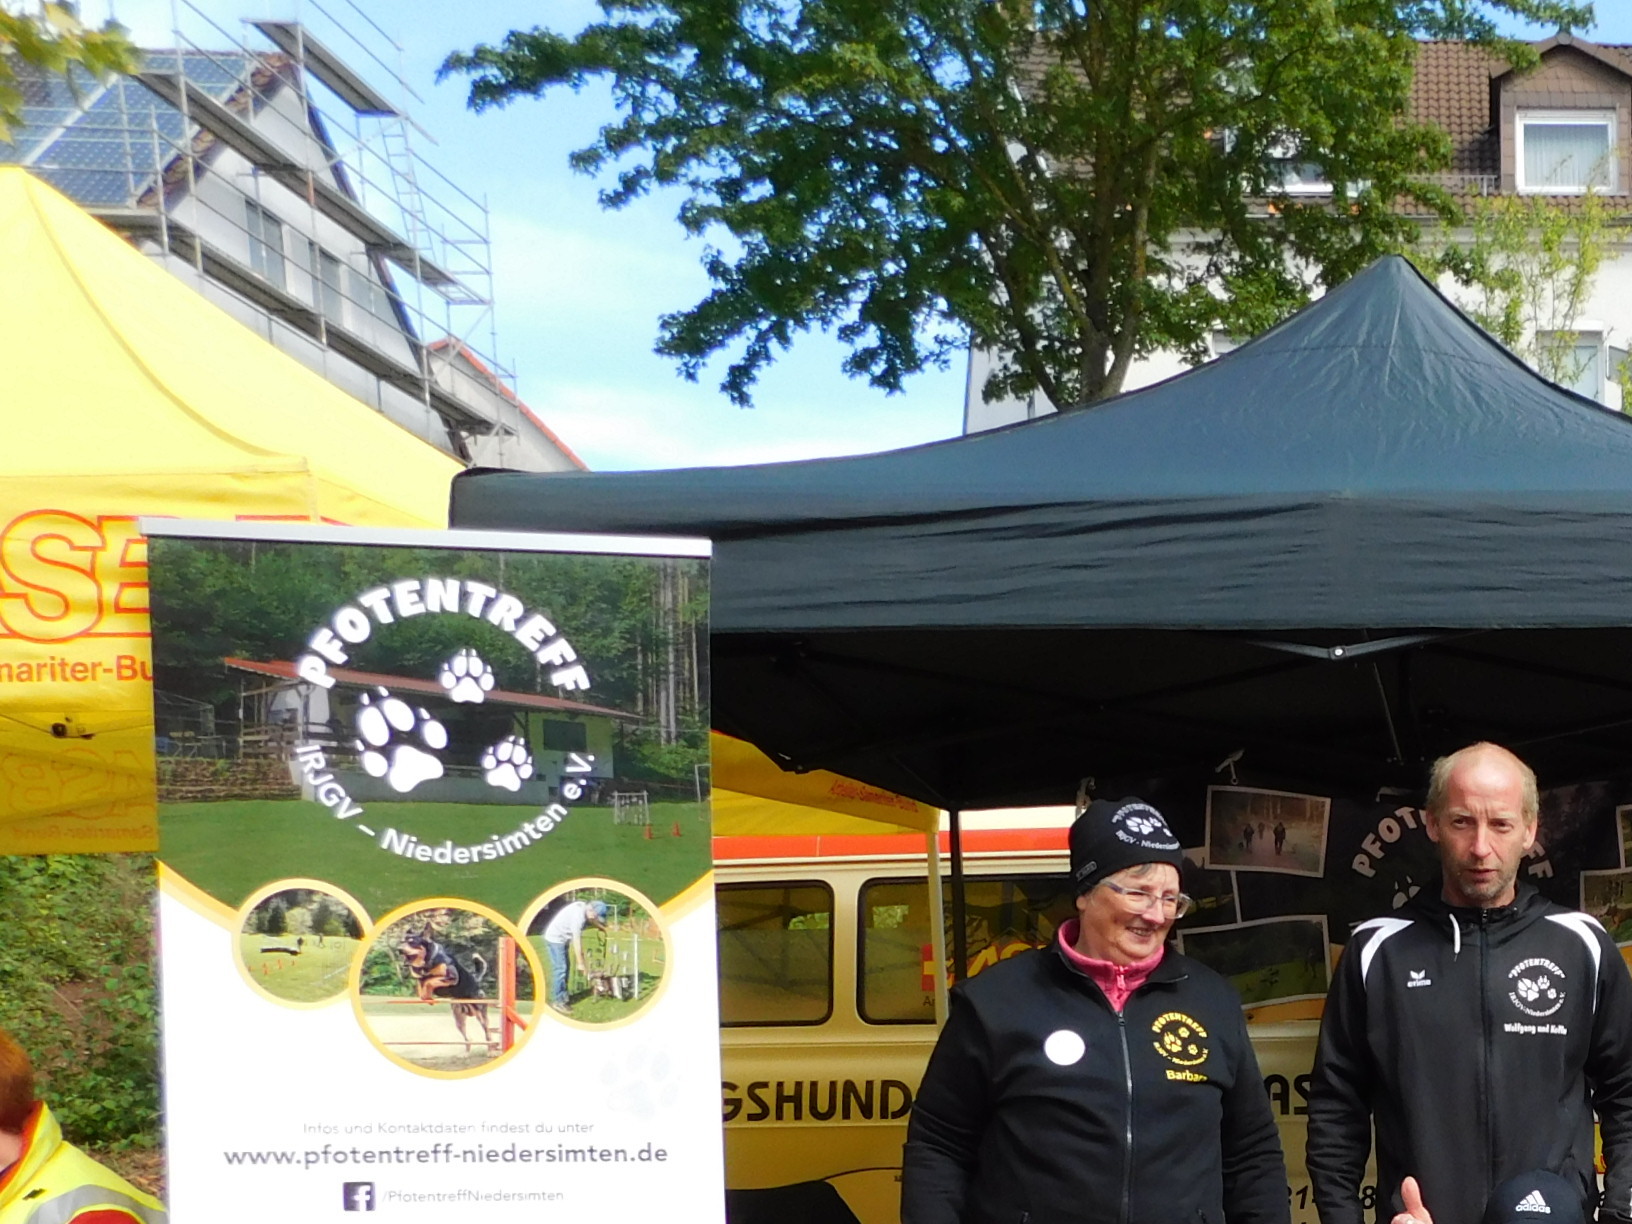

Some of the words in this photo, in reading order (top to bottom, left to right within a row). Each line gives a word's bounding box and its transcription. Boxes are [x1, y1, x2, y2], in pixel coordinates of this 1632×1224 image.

[299, 578, 590, 693] PFOTENTREFF
[295, 741, 363, 820] IRJGV
[380, 800, 567, 866] Niedersimten
[563, 752, 595, 799] e.V.
[722, 1079, 913, 1122] GSHUND
[345, 1122, 373, 1134] und
[378, 1121, 476, 1134] Kontaktdaten
[481, 1121, 530, 1133] findest
[535, 1121, 553, 1133] du
[558, 1122, 595, 1133] unter
[223, 1141, 668, 1171] www.pfotentreff-niedersimten.de
[1515, 1203, 1551, 1214] adidas
